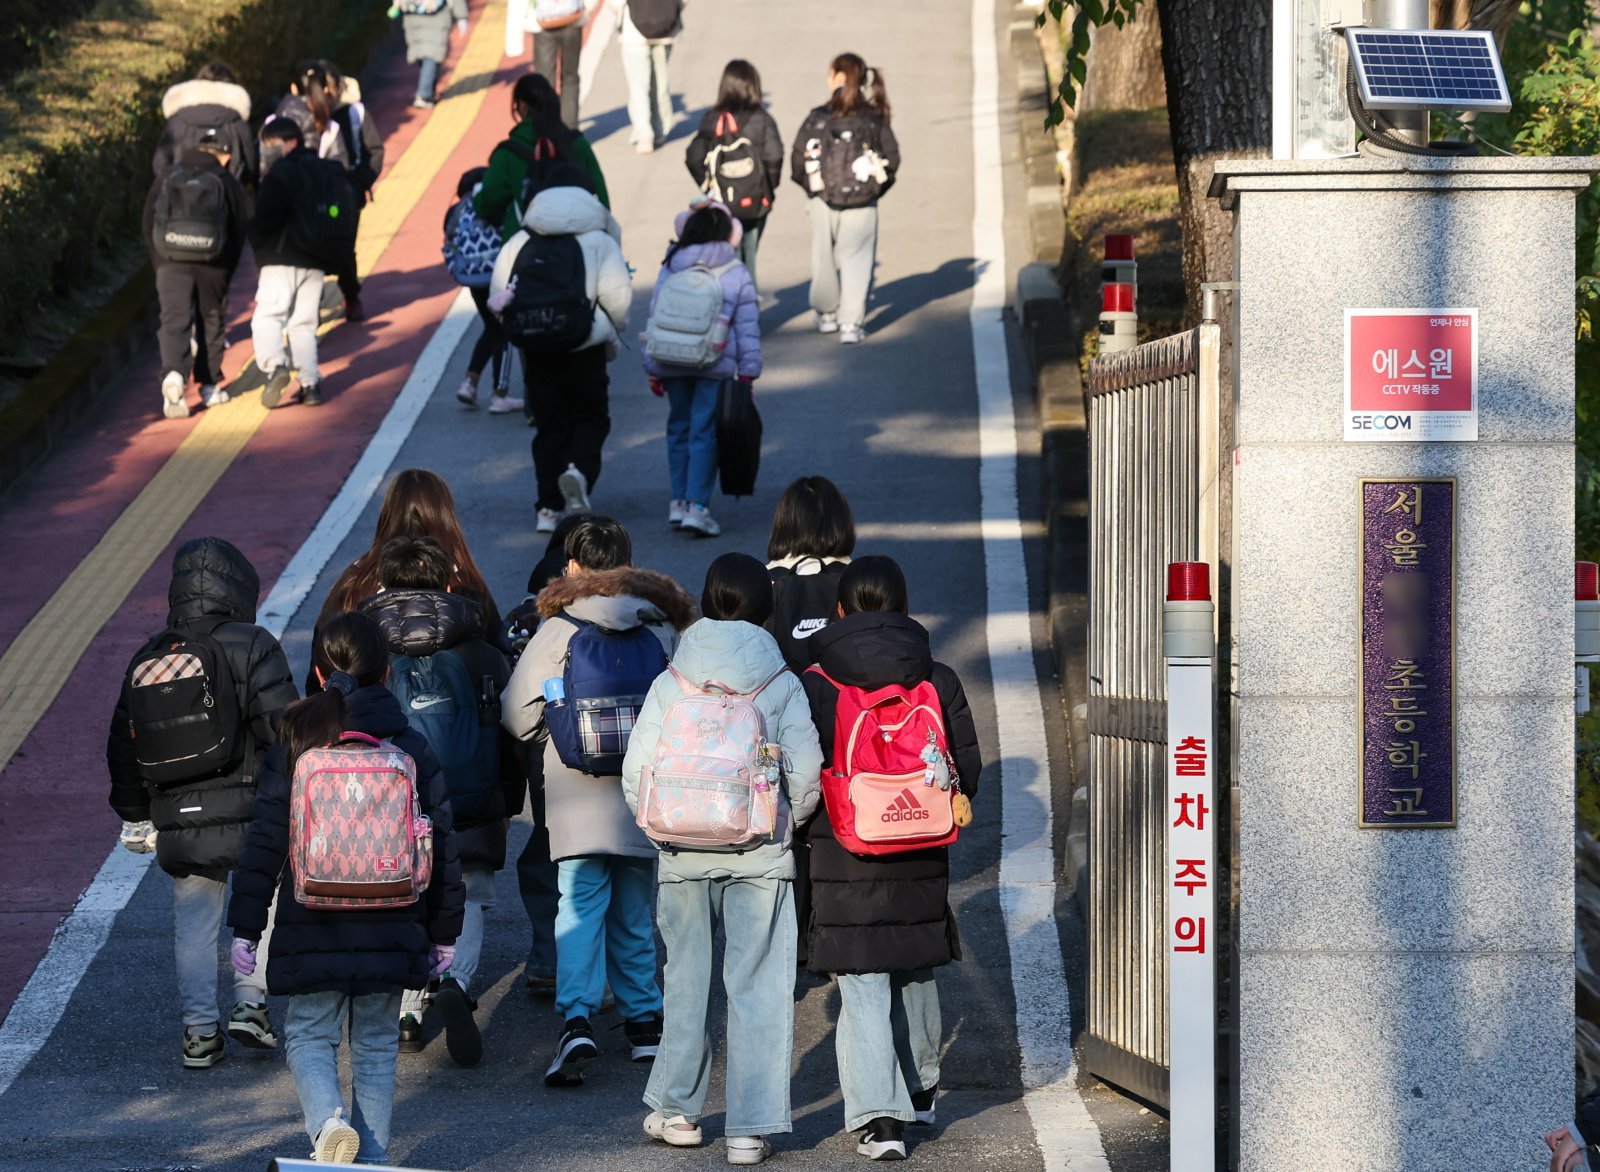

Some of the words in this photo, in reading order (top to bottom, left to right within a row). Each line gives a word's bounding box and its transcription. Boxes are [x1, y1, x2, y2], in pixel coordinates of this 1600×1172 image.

[1430, 318, 1452, 327] 언제나
[1454, 318, 1469, 327] 안심
[1372, 348, 1453, 380] 에스원
[1382, 384, 1411, 395] CCTV
[1412, 384, 1441, 395] 작동중
[1352, 415, 1412, 430] SECOM
[798, 618, 827, 629] NIKE
[881, 808, 930, 823] adidas
